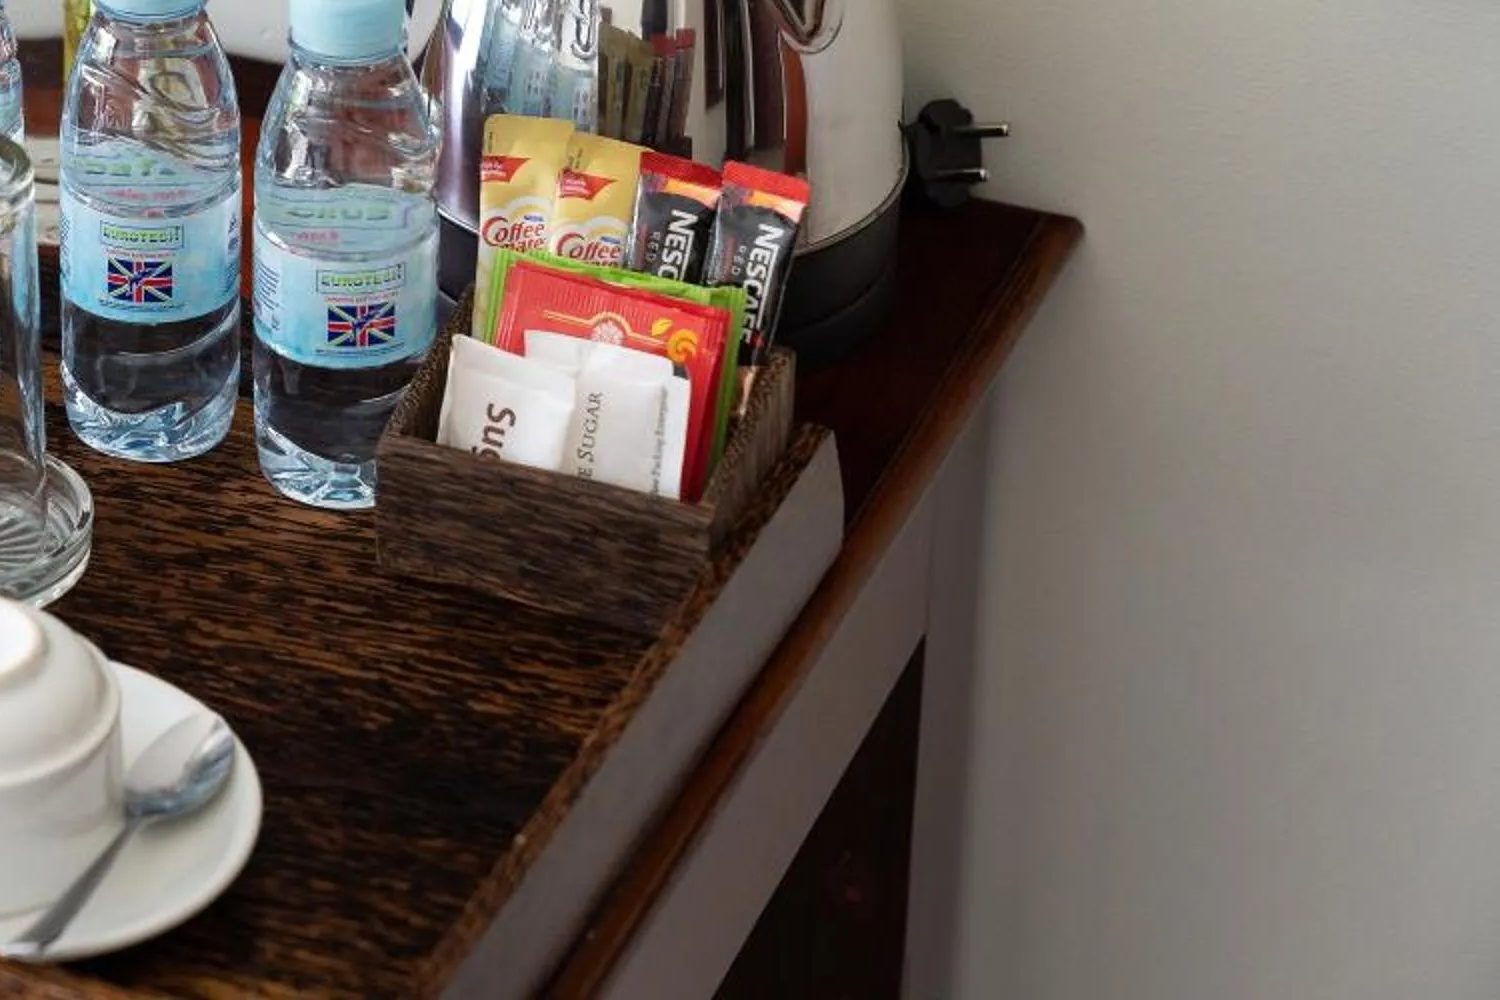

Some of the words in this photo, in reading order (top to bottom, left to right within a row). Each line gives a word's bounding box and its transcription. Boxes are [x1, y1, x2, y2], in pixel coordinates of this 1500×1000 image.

[483, 216, 544, 247] Coffee
[556, 232, 620, 259] Coffee
[658, 209, 699, 281] NESC
[577, 391, 604, 463] SUGAR
